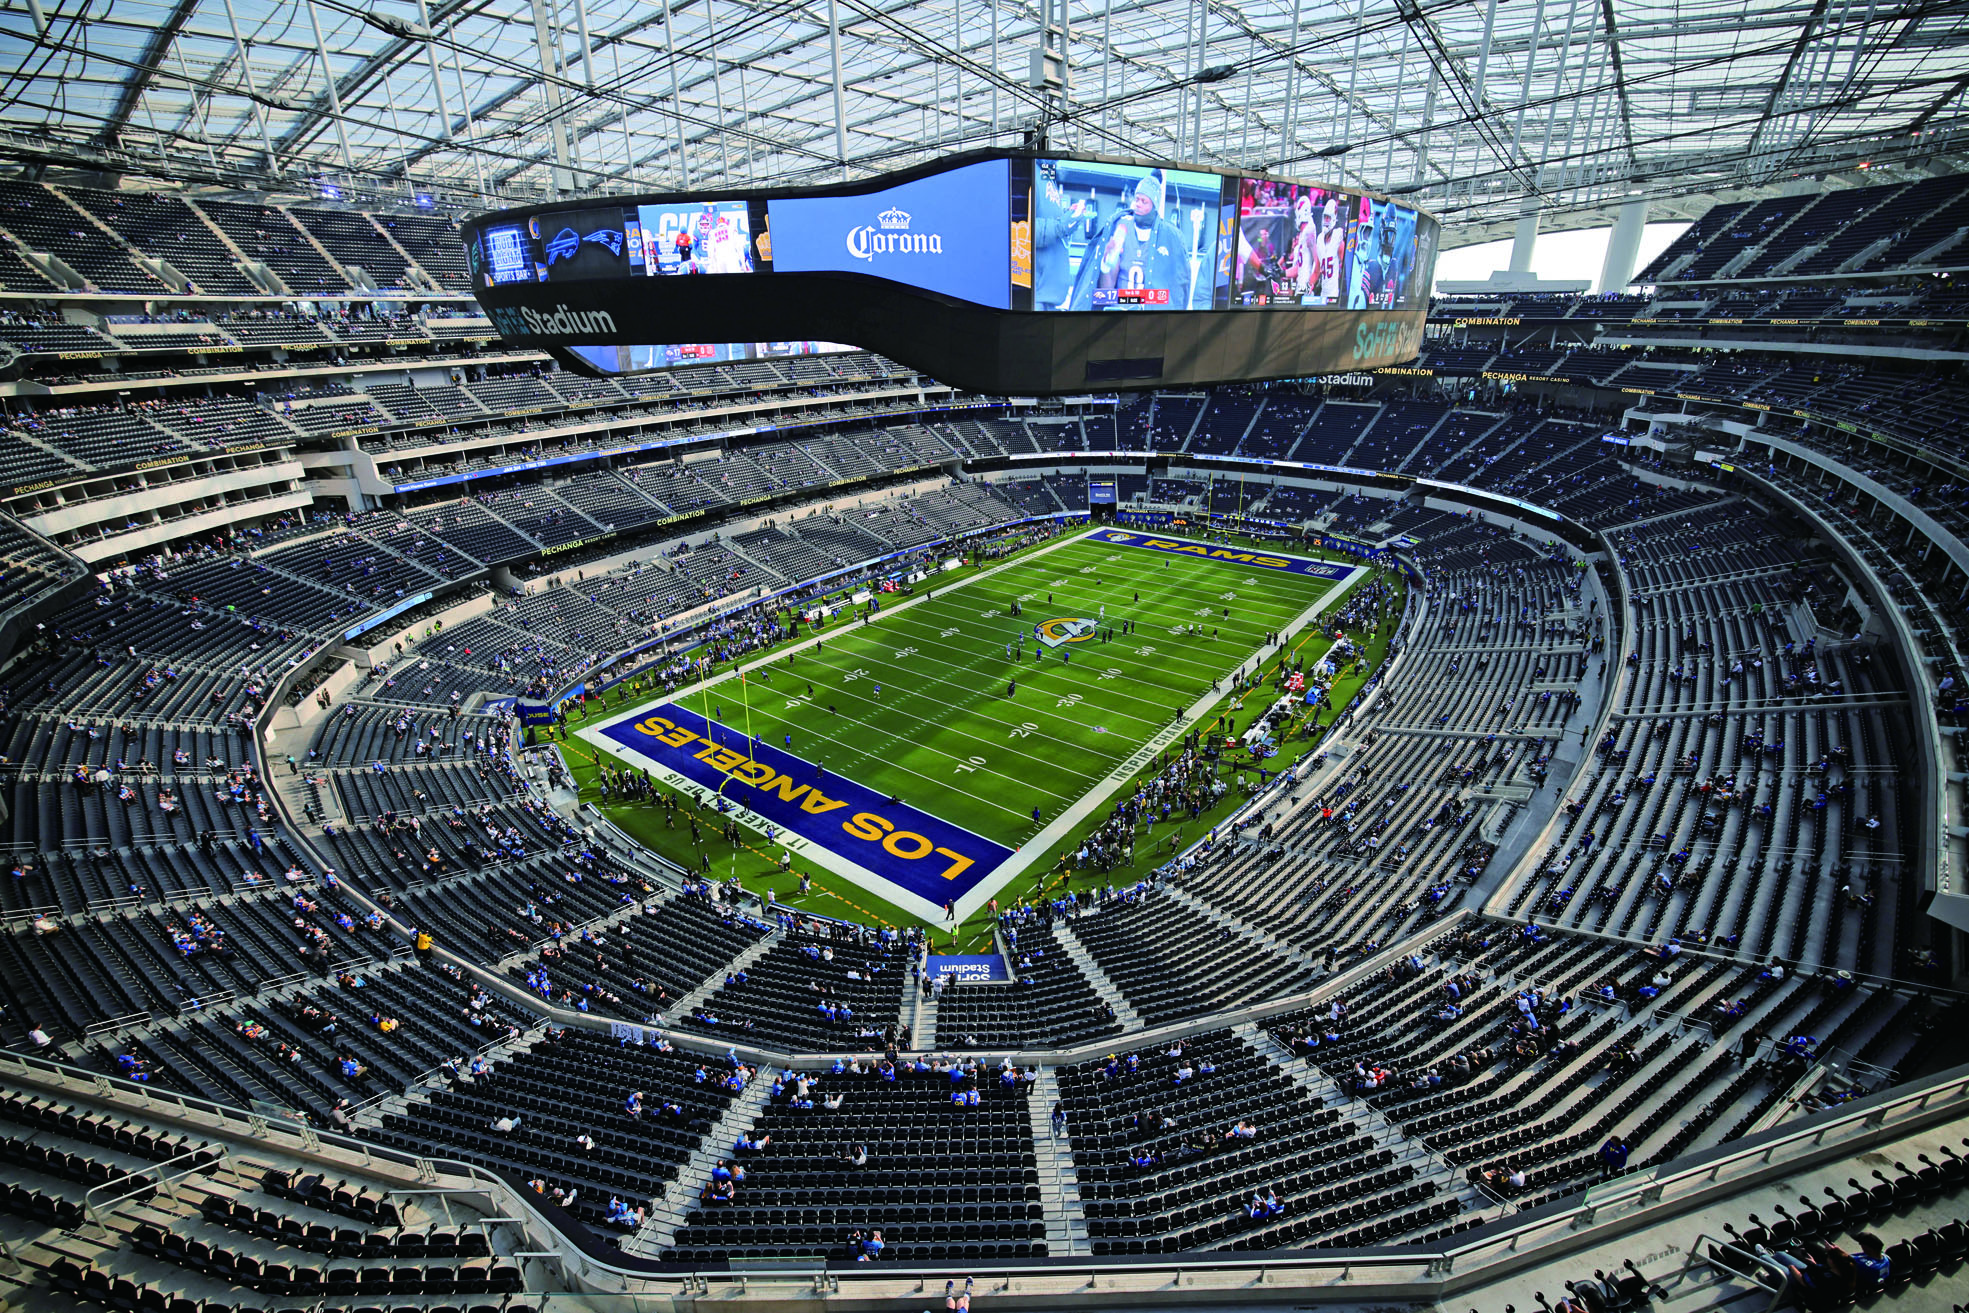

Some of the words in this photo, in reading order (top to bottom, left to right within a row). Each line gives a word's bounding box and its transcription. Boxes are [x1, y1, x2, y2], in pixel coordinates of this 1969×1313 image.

[494, 236, 514, 250] BUD
[846, 225, 943, 262] Corona
[1321, 256, 1334, 280] 45
[496, 271, 514, 282] SPORTS
[516, 269, 528, 280] BAR
[1107, 291, 1117, 300] 17
[1149, 291, 1154, 300] 0
[520, 304, 617, 335] Stadium
[1455, 318, 1520, 326] COMBINATION
[1353, 321, 1388, 360] SoFi
[59, 352, 102, 360] PECHANGA
[188, 346, 244, 355] COMBINATION
[1319, 372, 1373, 386] Stadium
[1482, 372, 1527, 382] PECHANGA
[504, 408, 542, 417] COMBINATION
[1742, 401, 1771, 411] COMBINATION
[415, 419, 446, 427] PECHANGA
[331, 427, 378, 438] COMBINATION
[226, 443, 265, 454] PECHANGA
[135, 456, 189, 470] COMBINATION
[894, 466, 919, 475] PECHANGA
[14, 480, 54, 495] PECHANGA
[829, 475, 866, 487] COMBINATION
[740, 495, 771, 505] PECHANGA
[657, 509, 705, 526] COMBINATION
[541, 539, 584, 556] PECHANGA
[585, 536, 601, 545] RESORT
[602, 533, 617, 541] CASINO
[1143, 540, 1292, 568] RAMS
[1135, 646, 1156, 657] 50
[844, 668, 870, 682] 20
[1101, 668, 1122, 680] 40
[1058, 694, 1084, 707] 30
[1010, 722, 1039, 738] 20
[1110, 746, 1157, 782] INSPIRE
[1153, 717, 1194, 745] CHANGE
[634, 716, 849, 816] ANGELES
[957, 756, 987, 773] 10
[664, 773, 684, 786] US
[684, 785, 706, 796] OF
[786, 838, 809, 850] IT
[842, 812, 975, 881] LOS
[940, 964, 990, 973] Stadium
